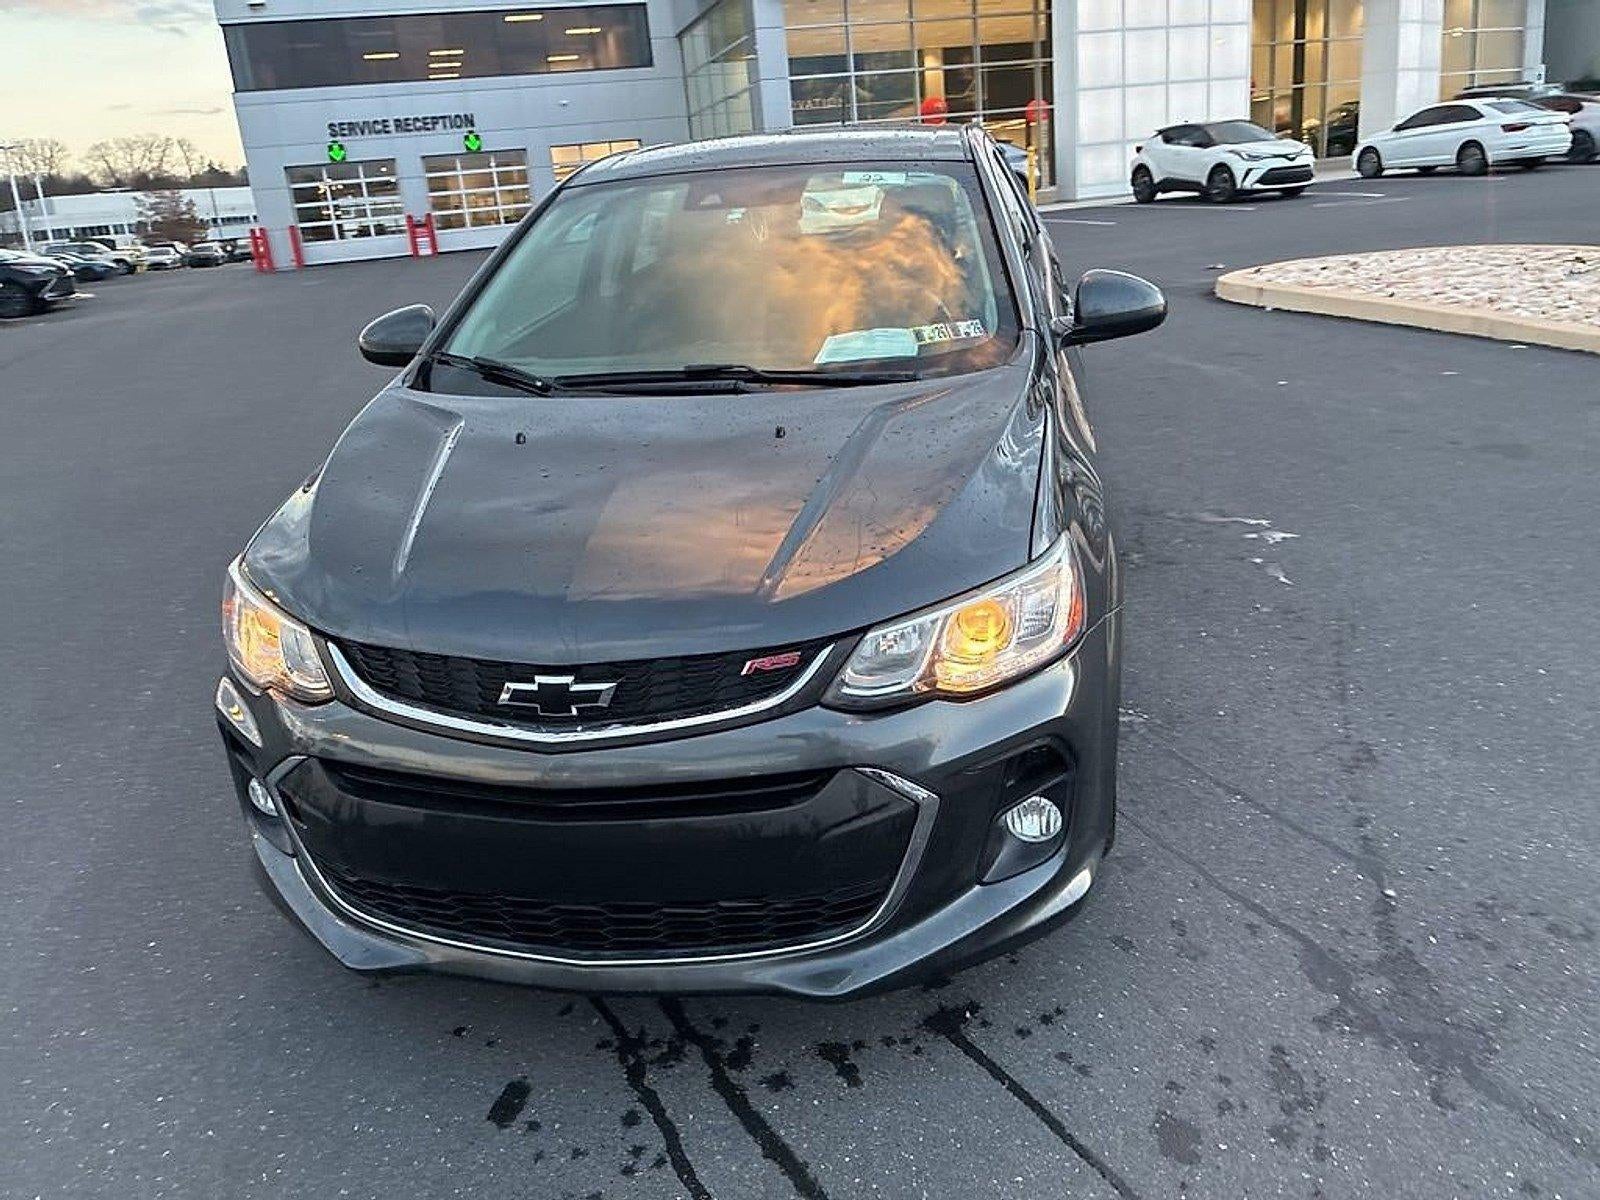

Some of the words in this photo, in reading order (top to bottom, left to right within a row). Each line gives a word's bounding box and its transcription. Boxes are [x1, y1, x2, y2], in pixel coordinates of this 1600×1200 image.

[328, 119, 392, 137] SERVICE
[394, 113, 475, 132] RECEPTION
[741, 652, 801, 675] RS
